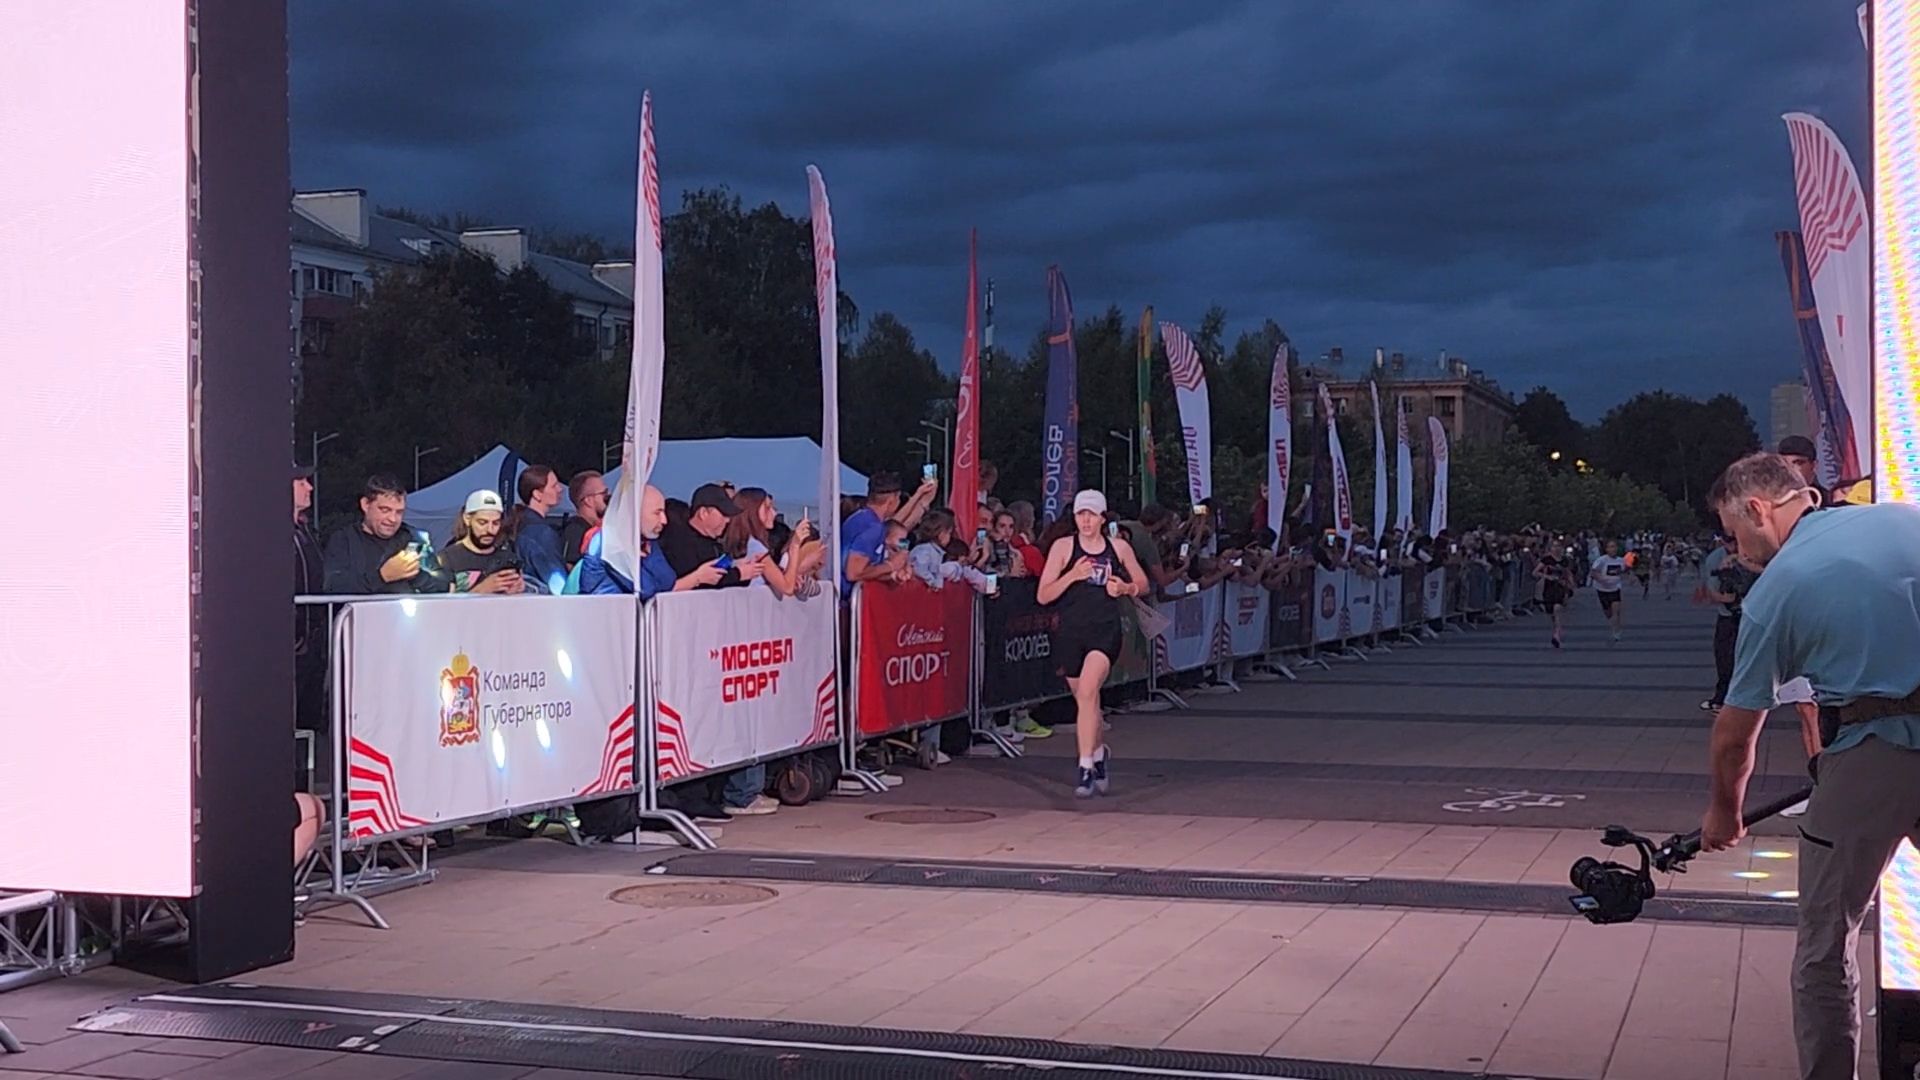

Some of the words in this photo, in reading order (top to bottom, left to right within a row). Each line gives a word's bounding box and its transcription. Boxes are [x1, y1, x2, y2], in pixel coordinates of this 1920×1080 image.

[722, 638, 793, 672] МОСОБЛ
[886, 651, 950, 686] СПОРТ
[483, 671, 546, 692] Команда
[723, 670, 780, 703] СПОРТ
[483, 700, 572, 731] Губернатора
